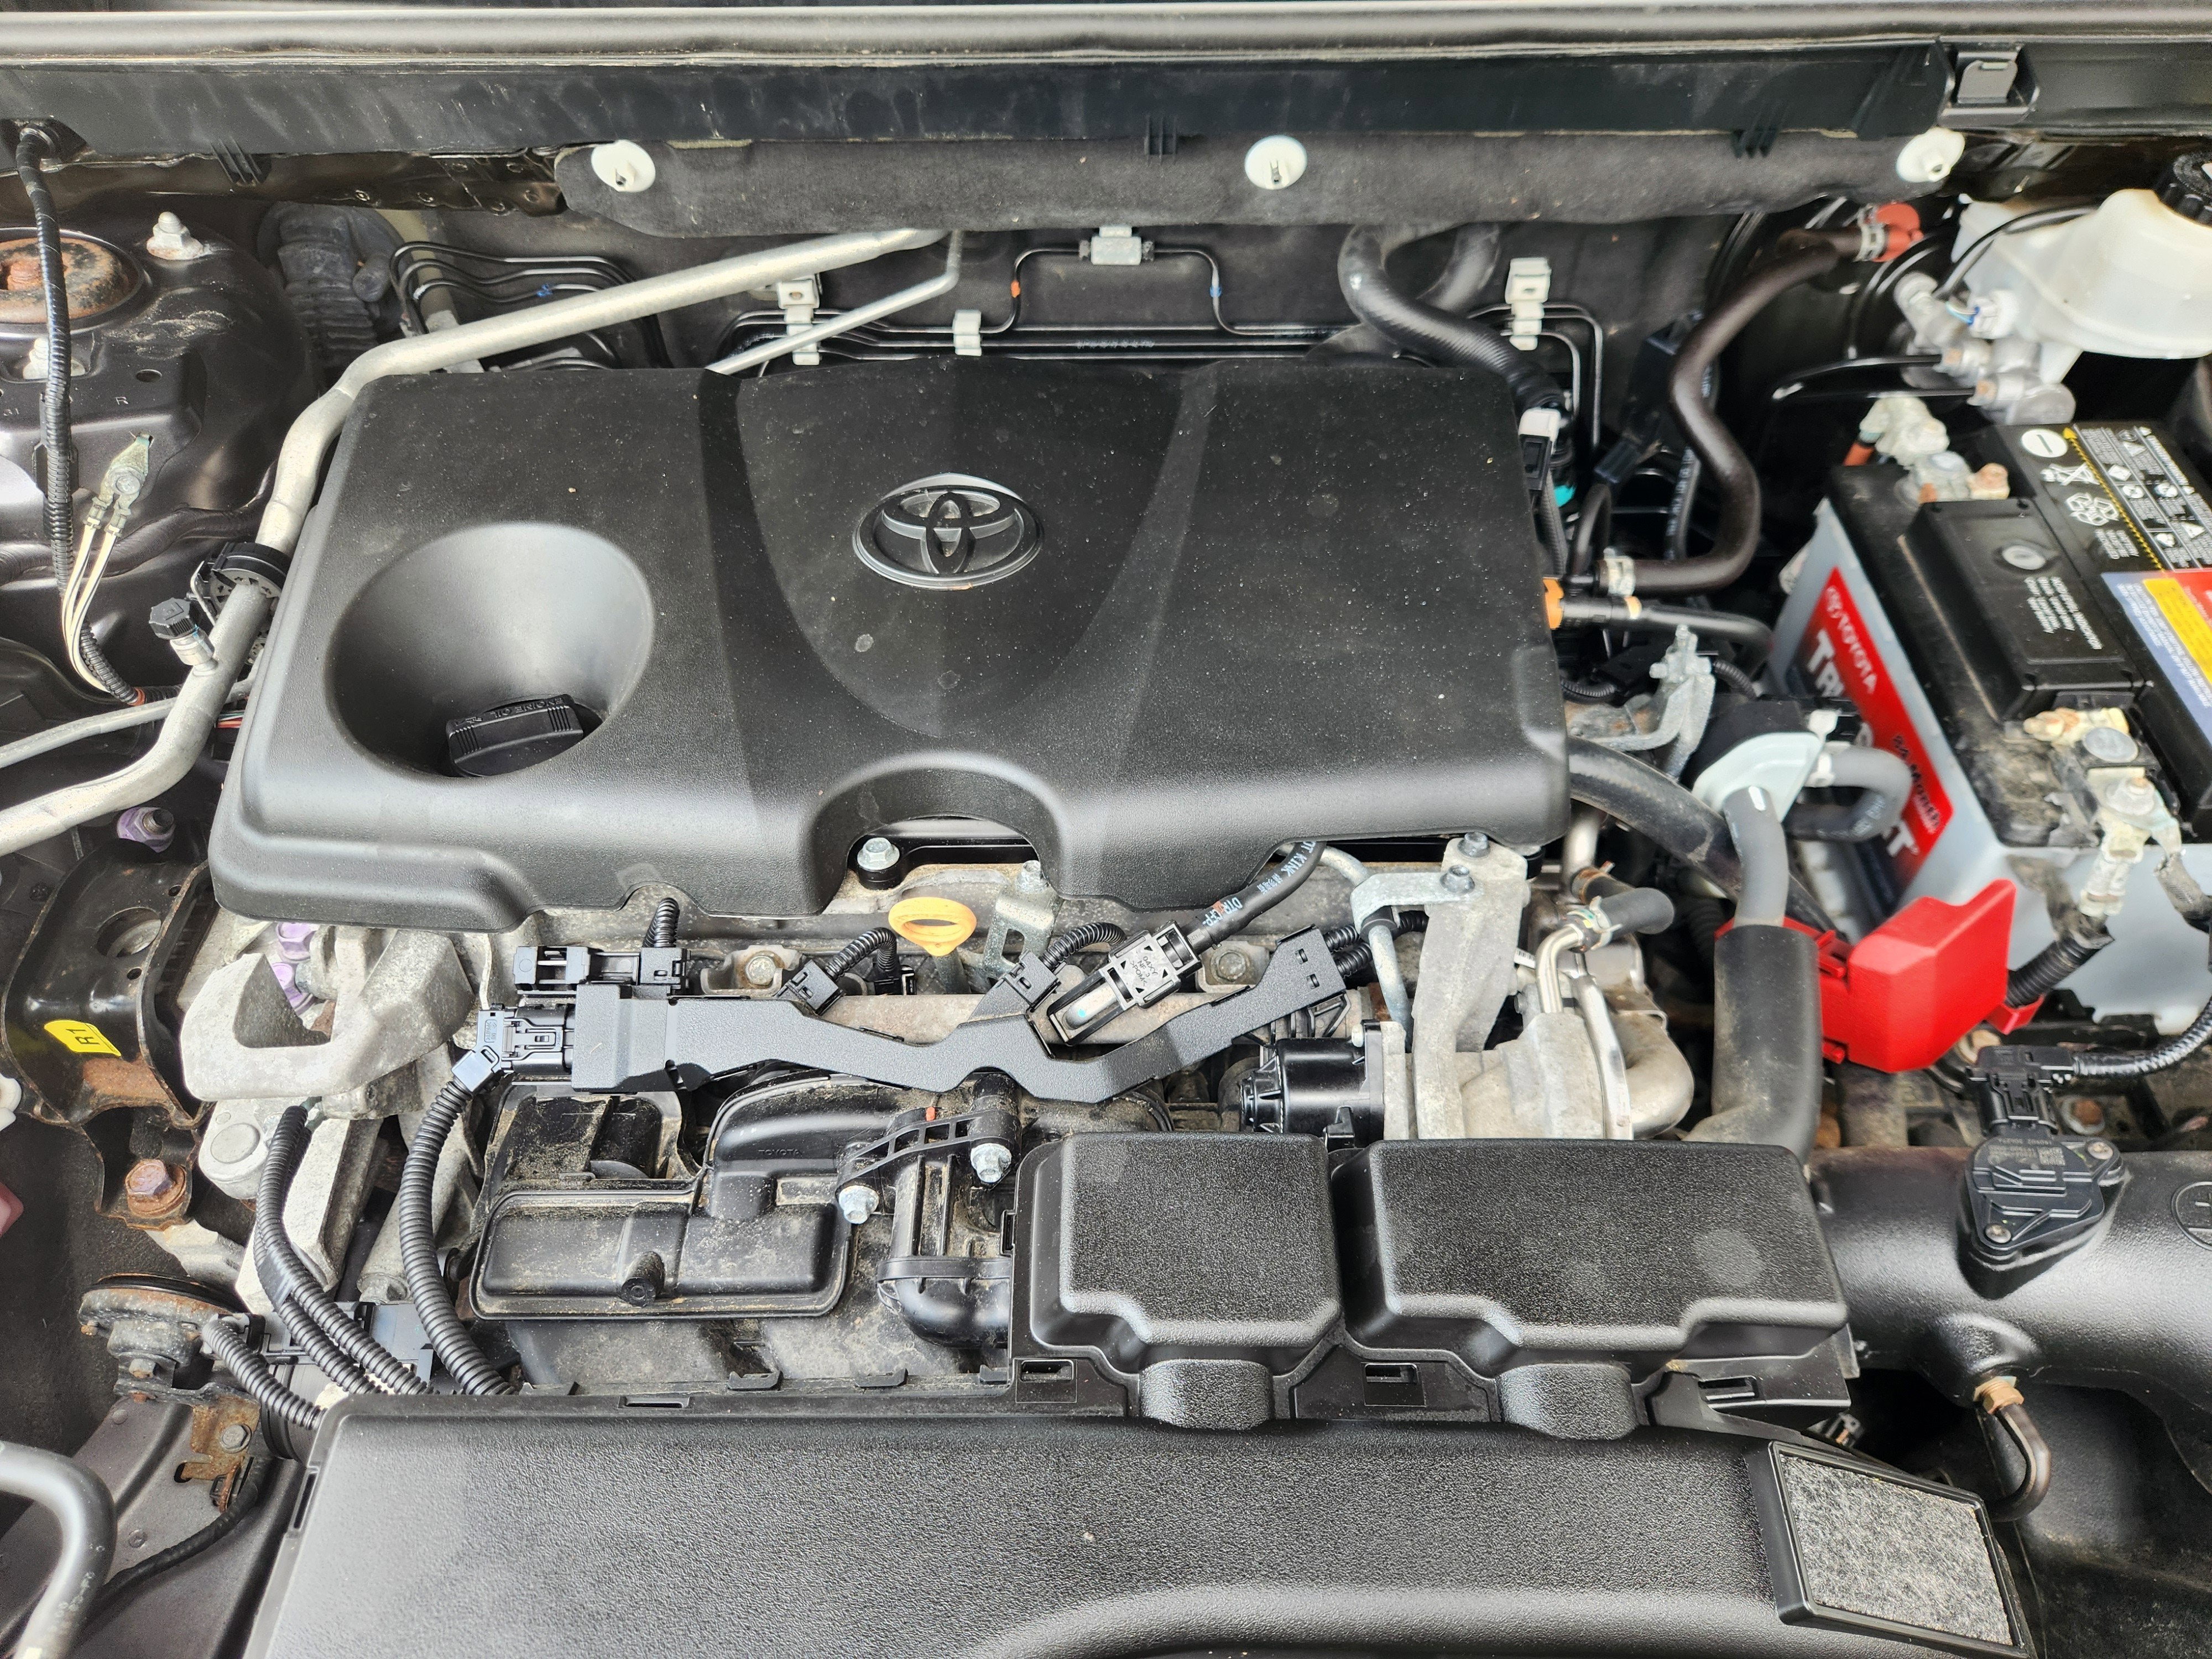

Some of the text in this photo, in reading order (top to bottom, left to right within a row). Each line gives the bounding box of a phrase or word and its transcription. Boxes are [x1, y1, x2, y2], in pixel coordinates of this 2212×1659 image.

[2072, 611, 2103, 650] INDICATOR
[489, 697, 564, 718] ENGINE OIL
[1301, 841, 1316, 853] OT
[1281, 852, 1307, 877] KINK
[1138, 960, 1146, 969] NF
[65, 1028, 101, 1046] R1
[758, 1149, 802, 1157] TOYOTA
